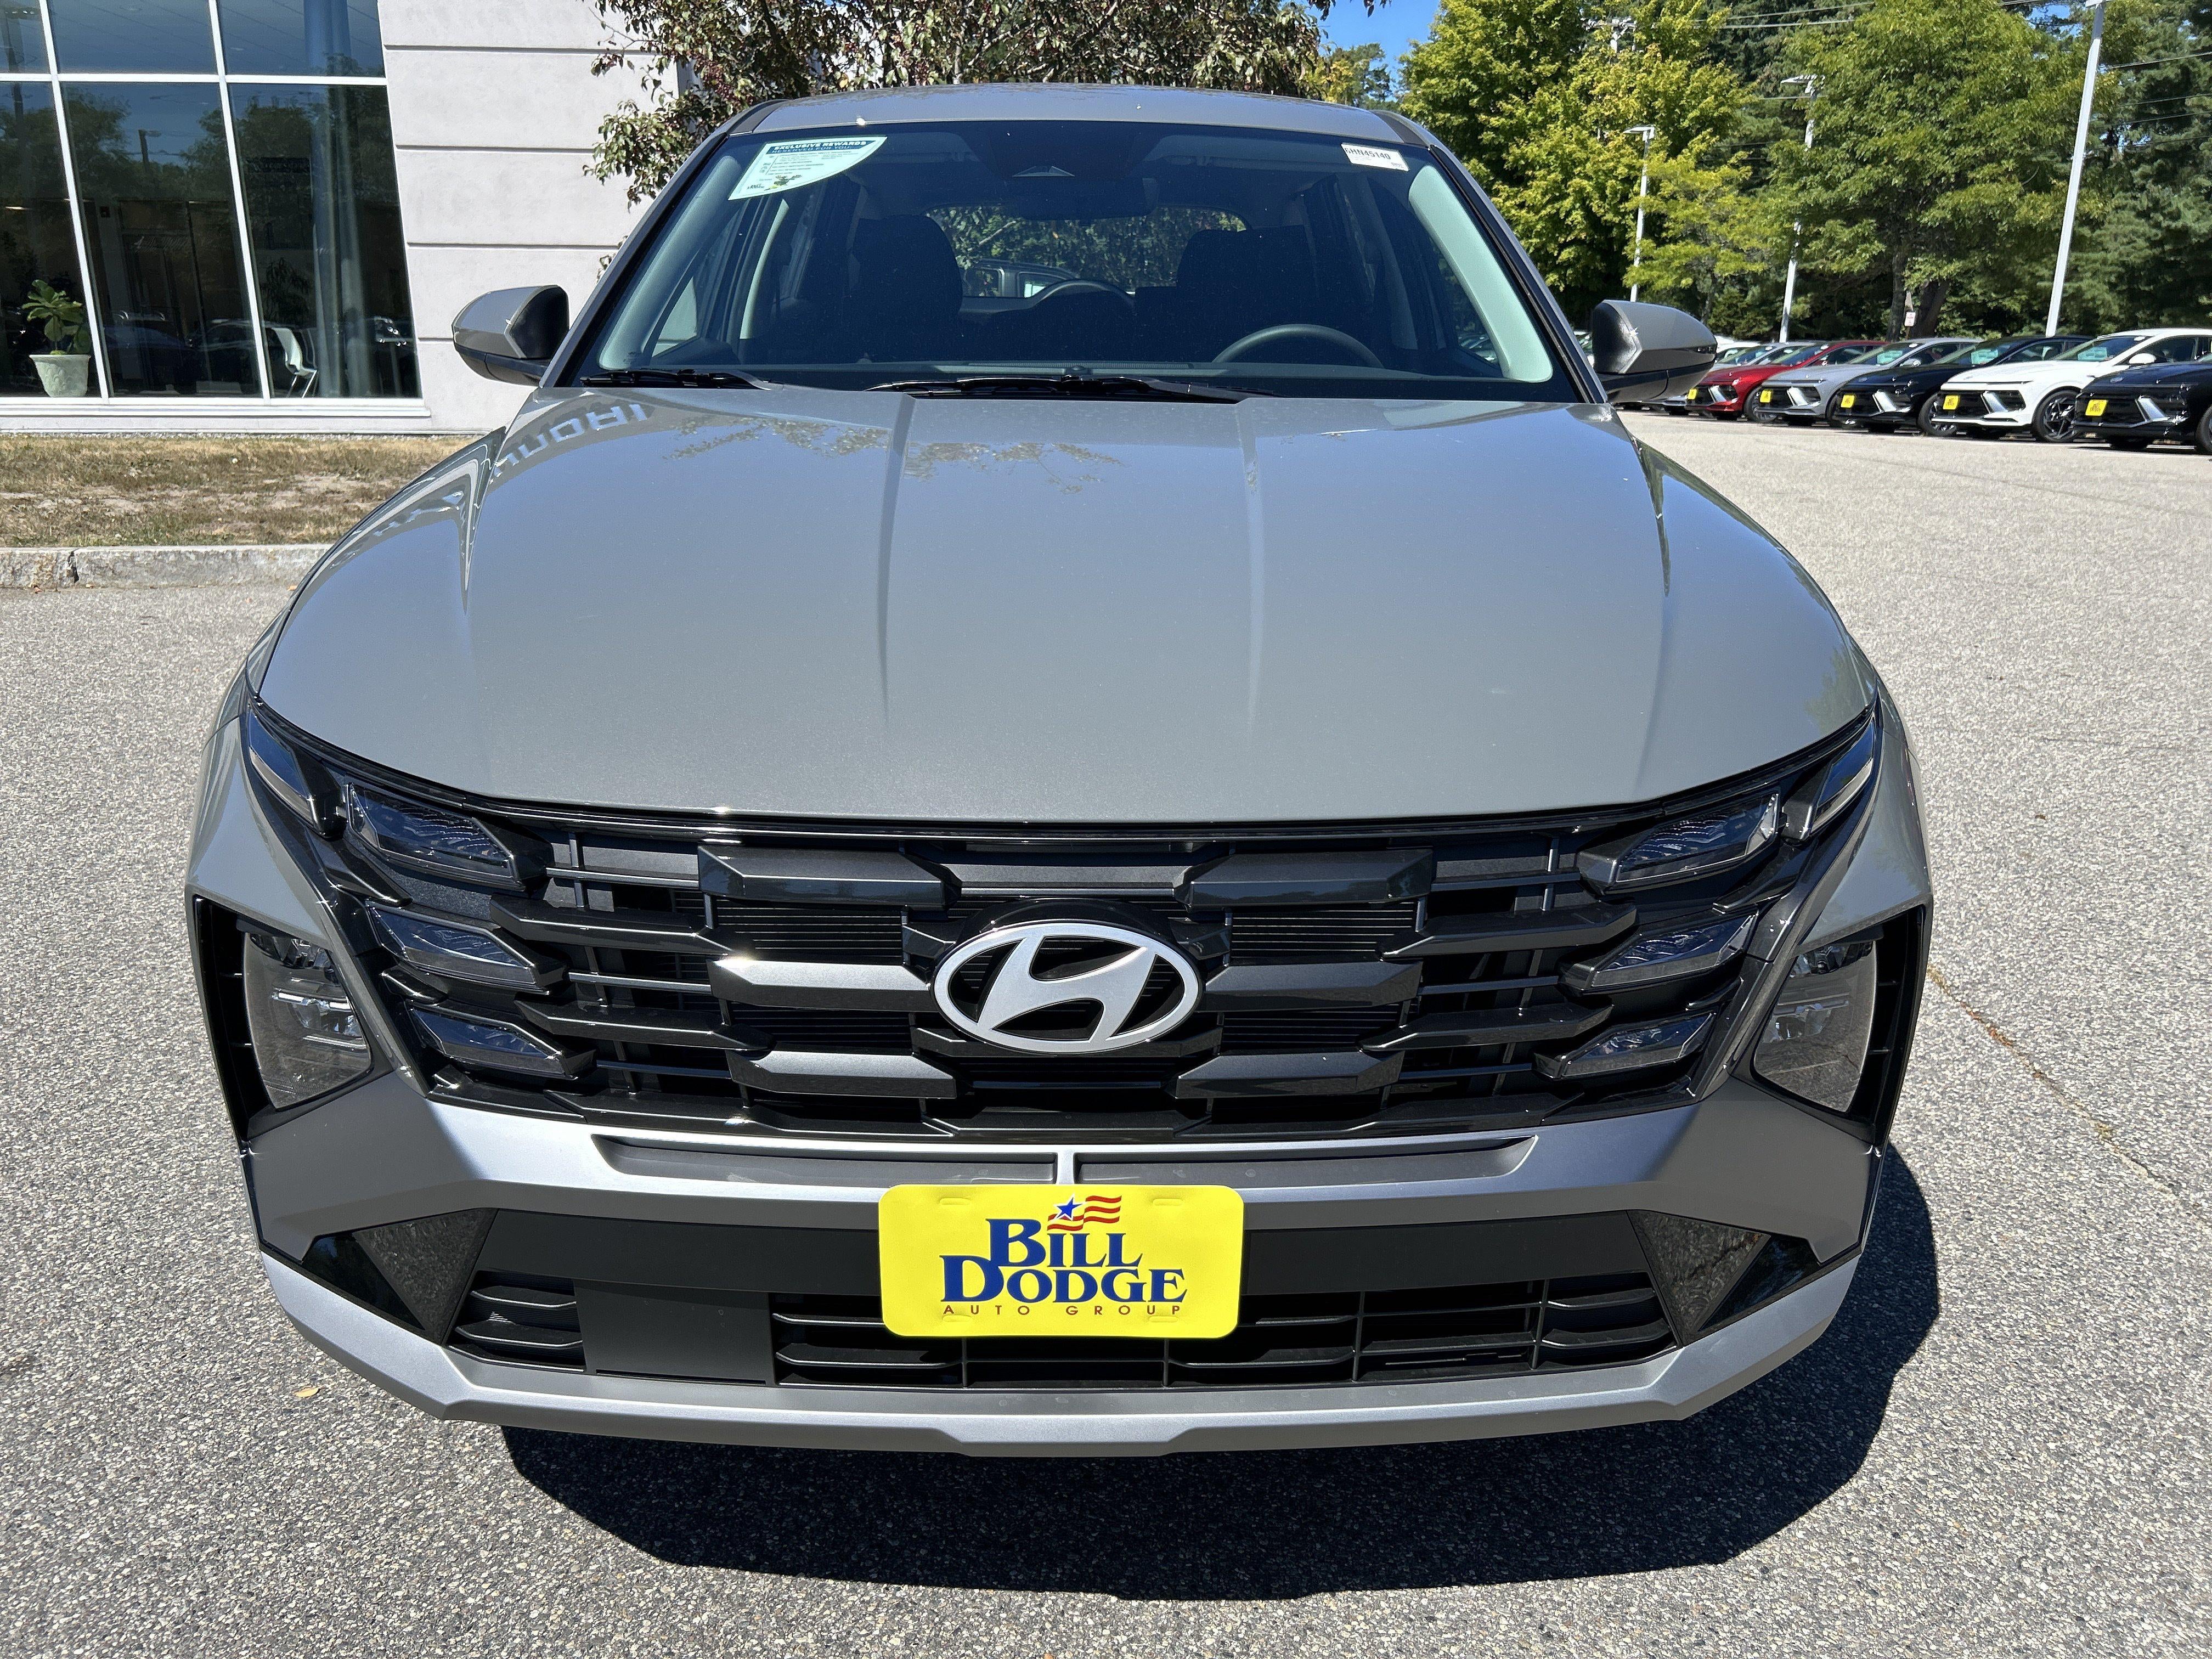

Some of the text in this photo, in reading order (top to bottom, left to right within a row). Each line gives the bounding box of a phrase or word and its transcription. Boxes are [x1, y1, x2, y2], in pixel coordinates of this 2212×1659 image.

[985, 1218, 1143, 1268] BILL
[939, 1255, 1188, 1303] DODGE
[943, 1305, 1181, 1316] AUTO GROUP
